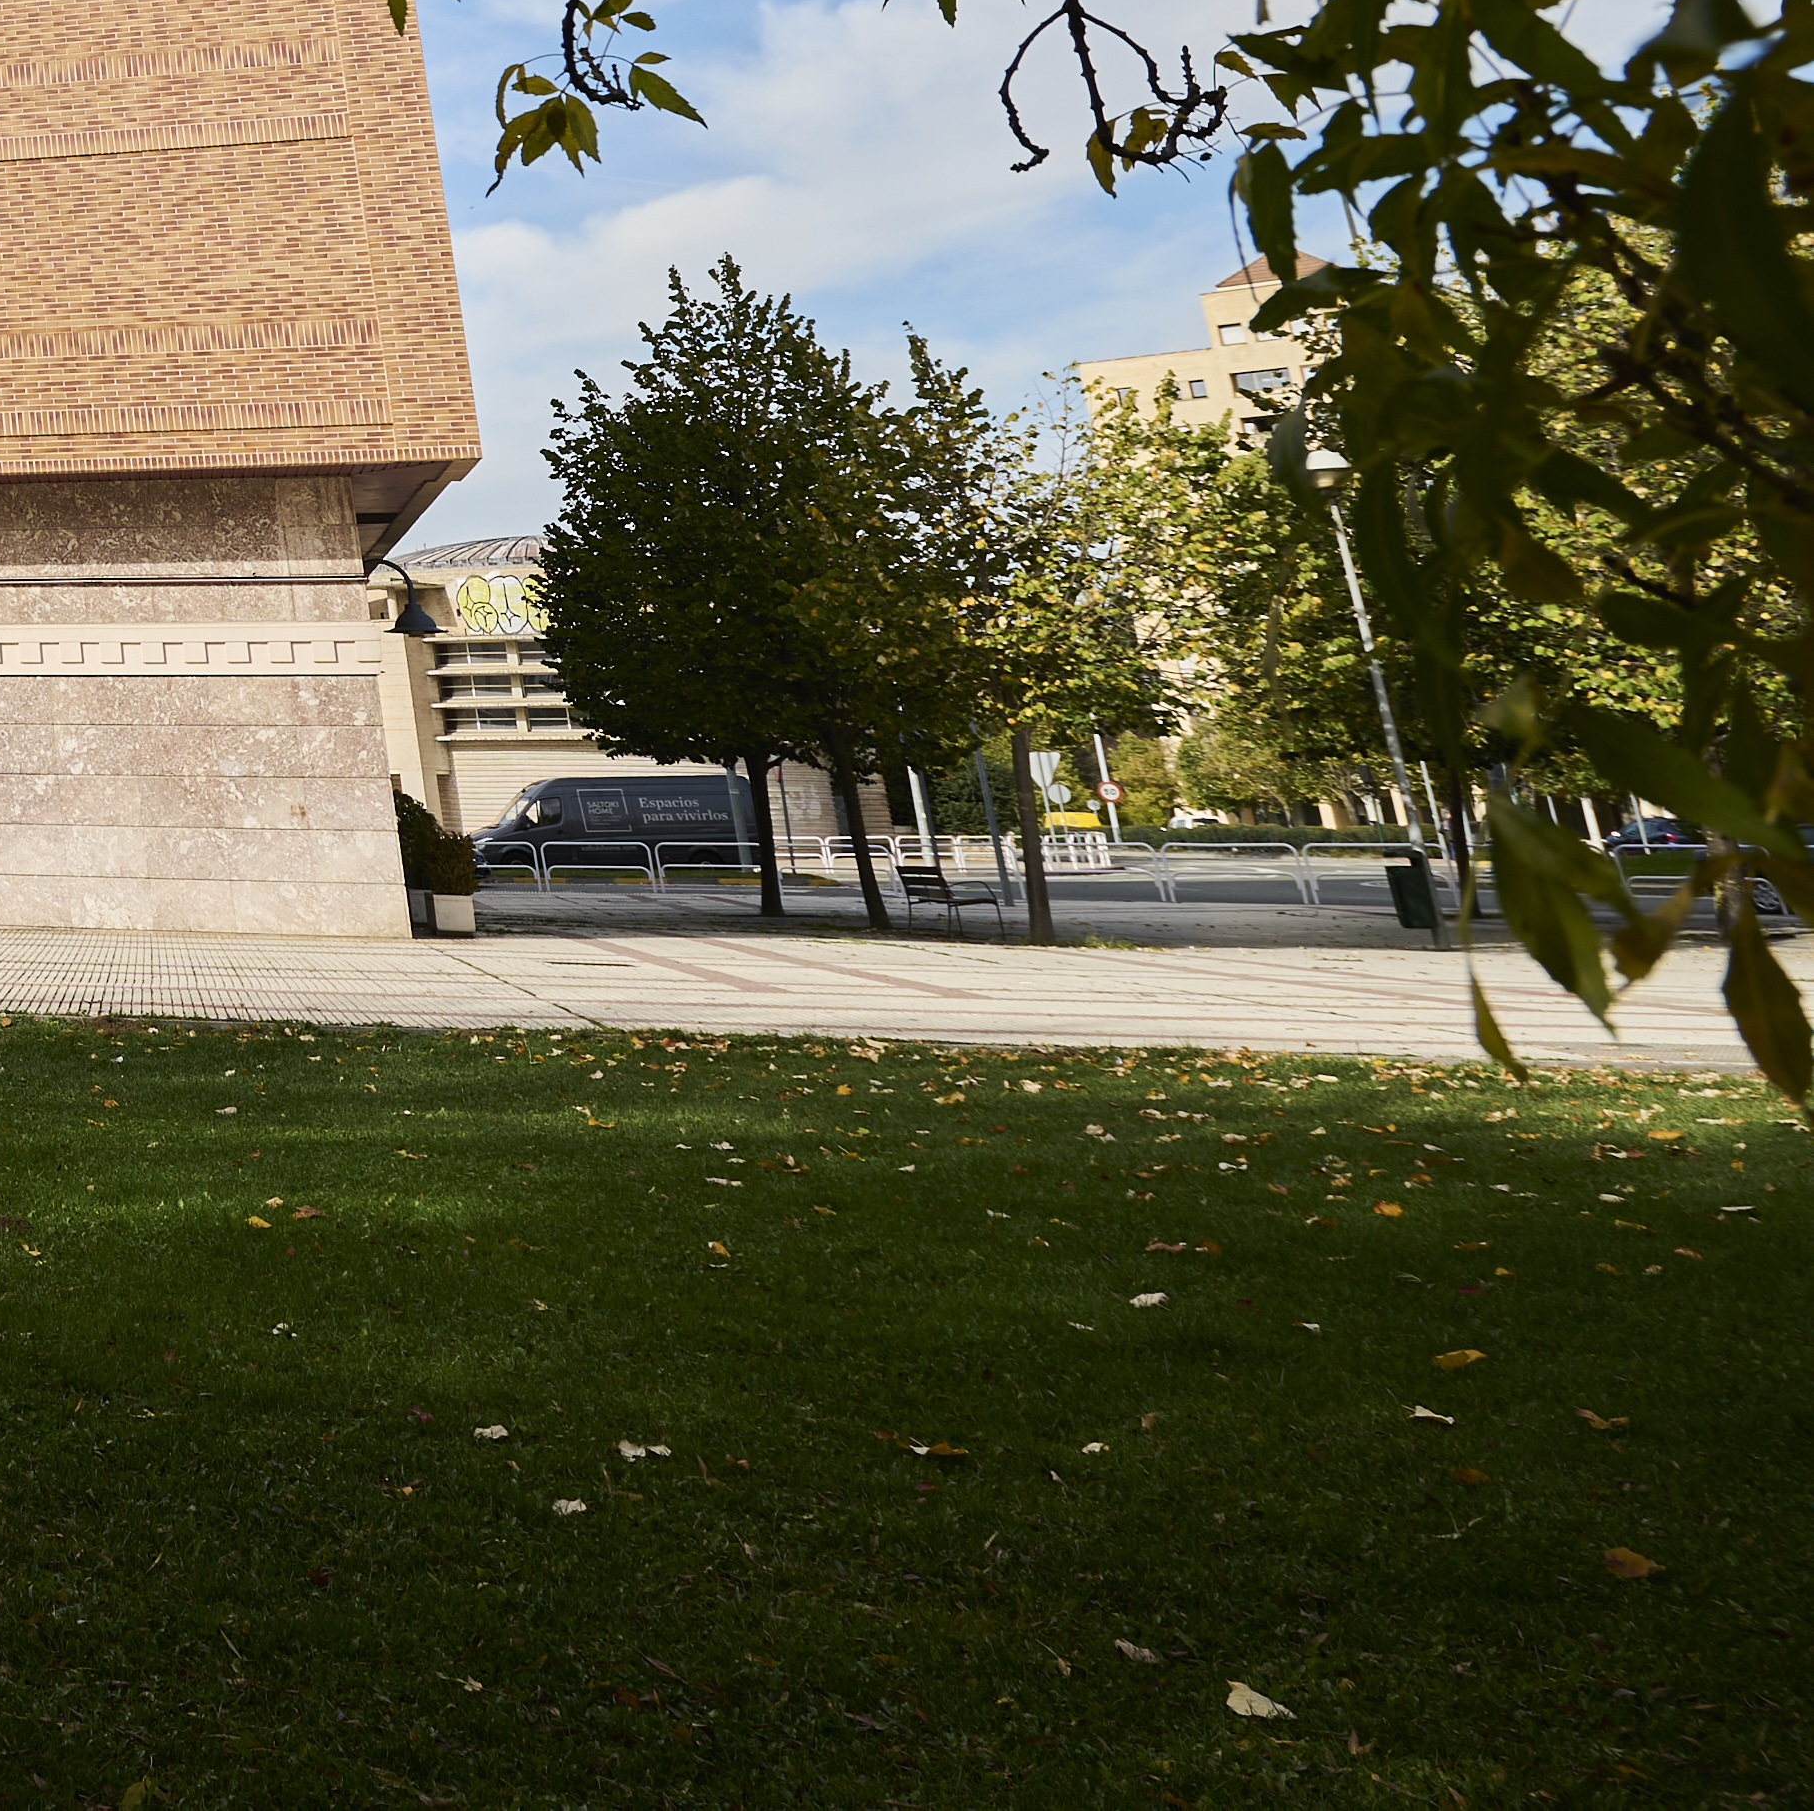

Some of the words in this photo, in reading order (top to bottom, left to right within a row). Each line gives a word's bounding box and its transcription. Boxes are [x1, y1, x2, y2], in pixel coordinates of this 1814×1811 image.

[638, 796, 700, 810] Espacios
[642, 812, 674, 824] para
[675, 809, 729, 821] vivirlos
